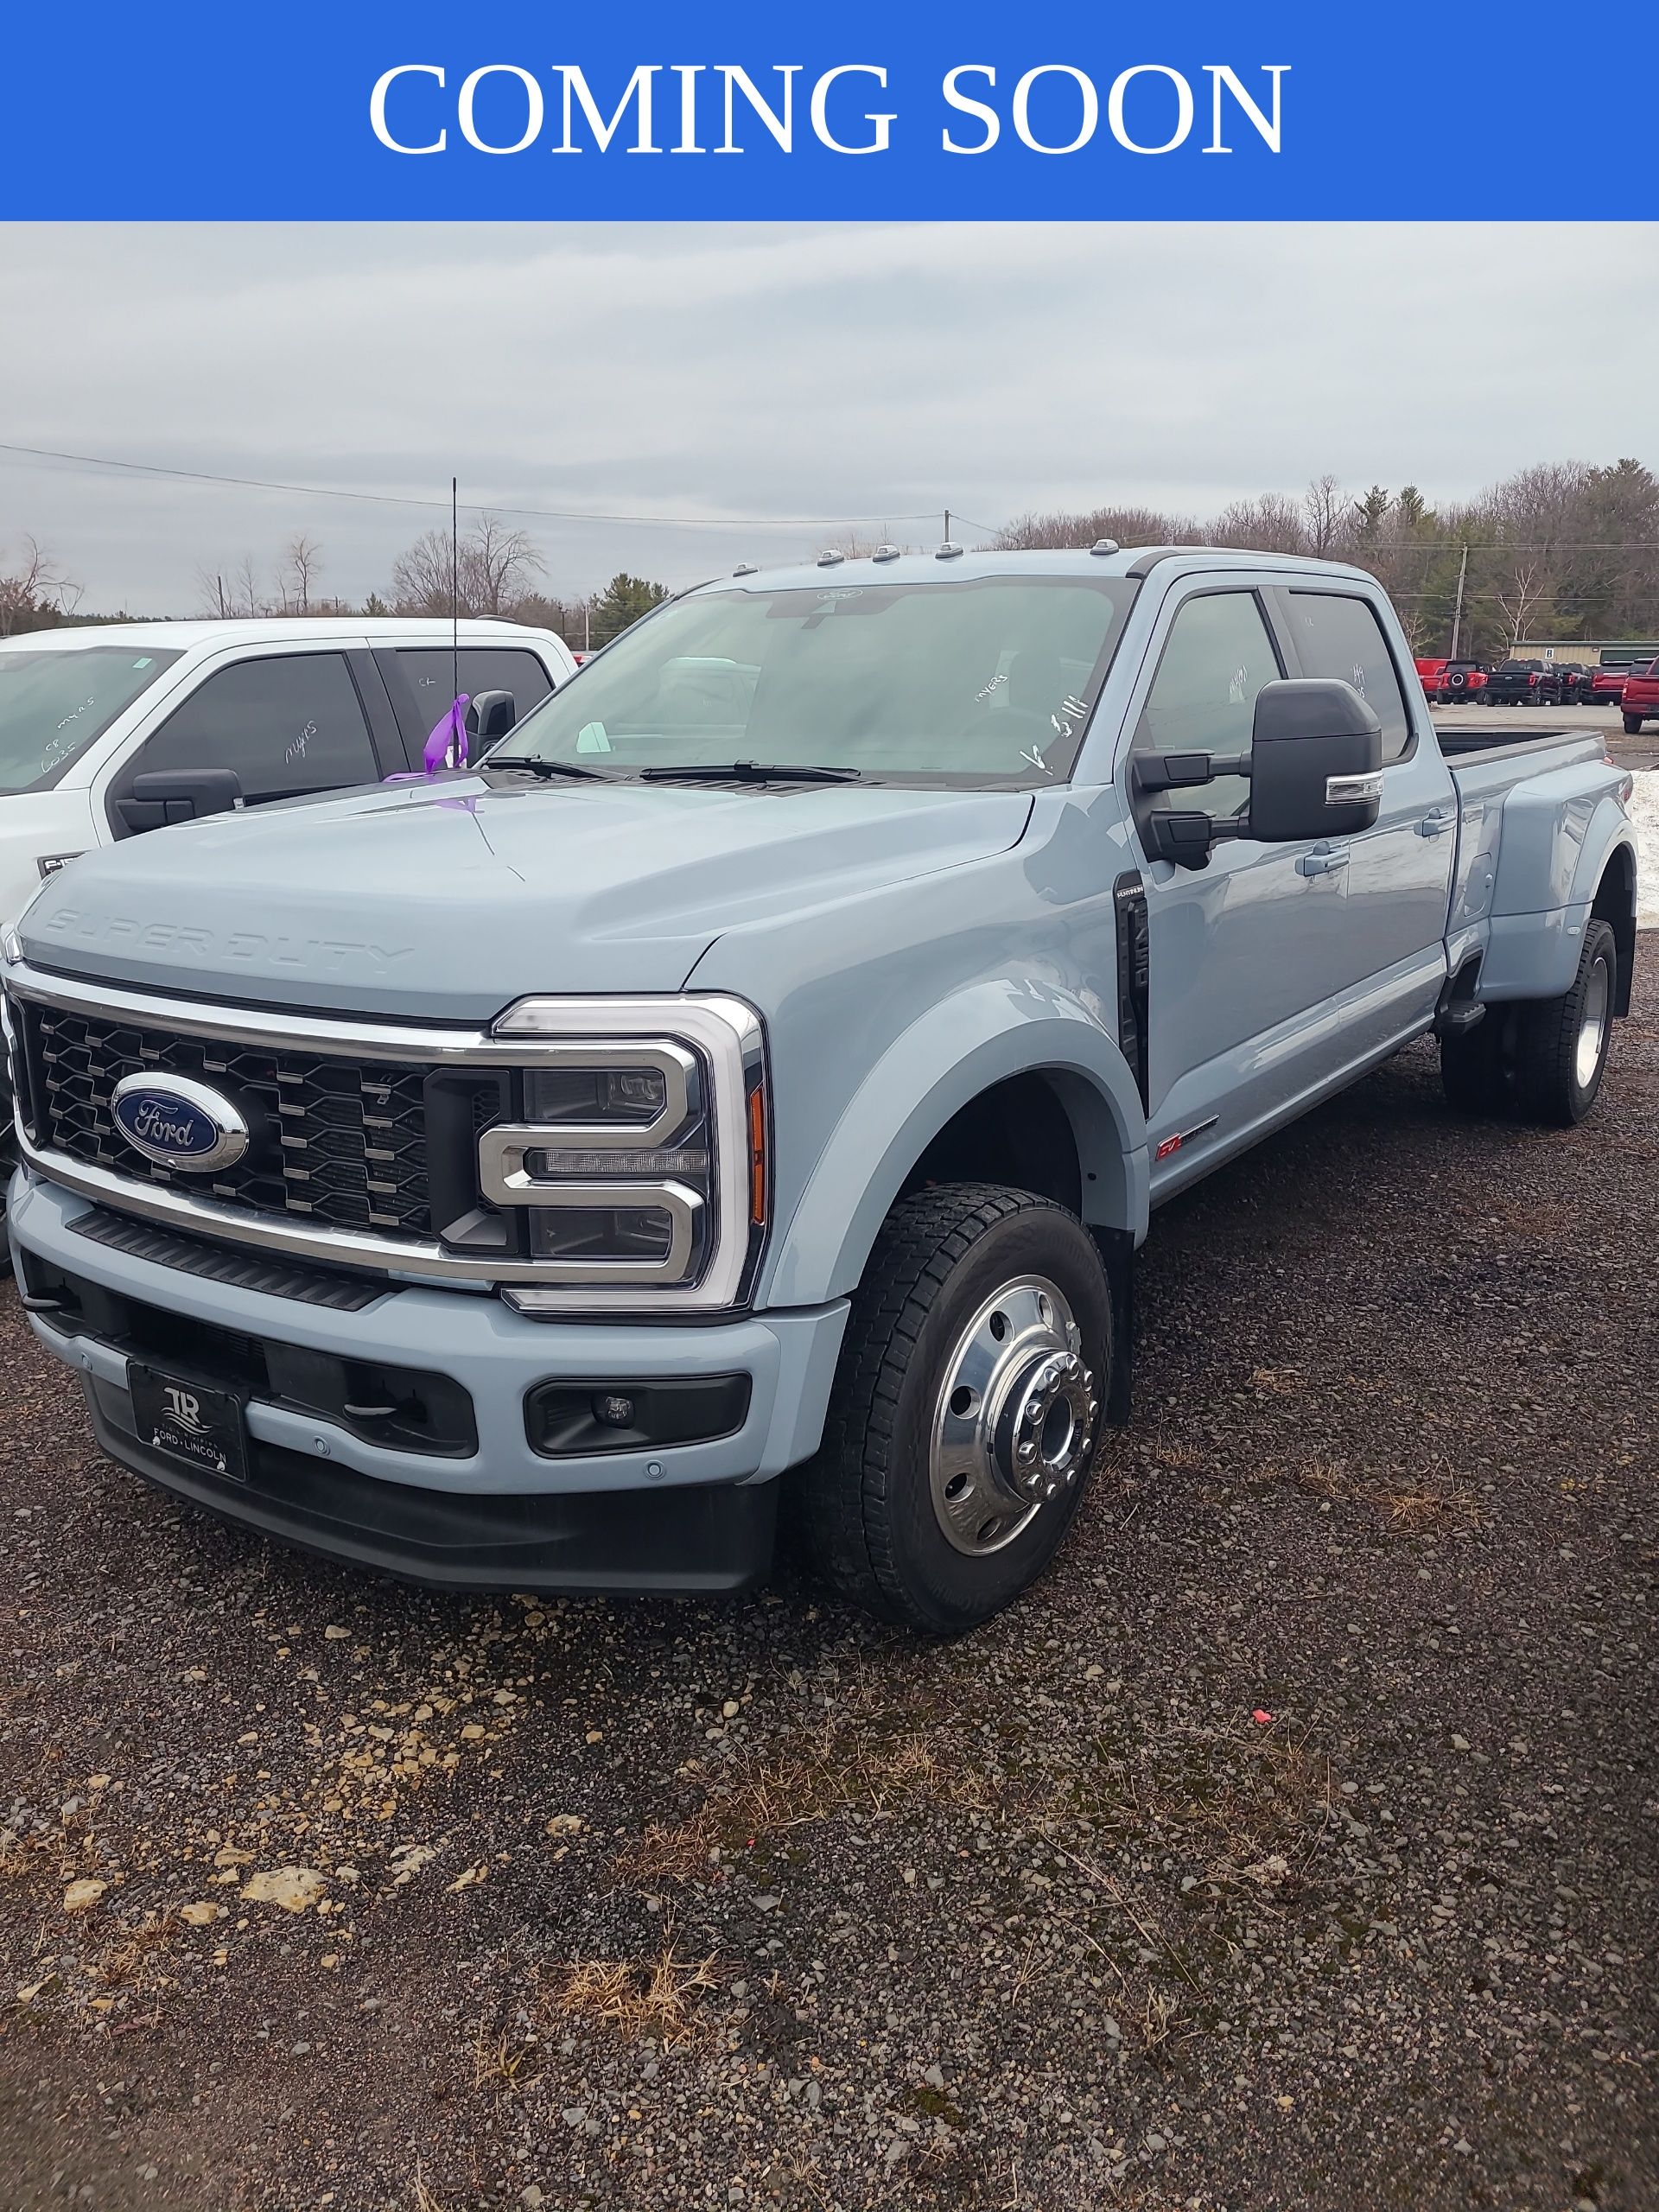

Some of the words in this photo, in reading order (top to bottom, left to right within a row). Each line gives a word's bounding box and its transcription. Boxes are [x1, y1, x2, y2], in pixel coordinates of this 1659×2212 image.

[46, 908, 214, 956] SUPER
[221, 932, 415, 974] DUTY
[134, 1099, 194, 1147] Ford
[153, 1427, 178, 1446] FORD
[184, 1439, 226, 1463] LINCOLN
